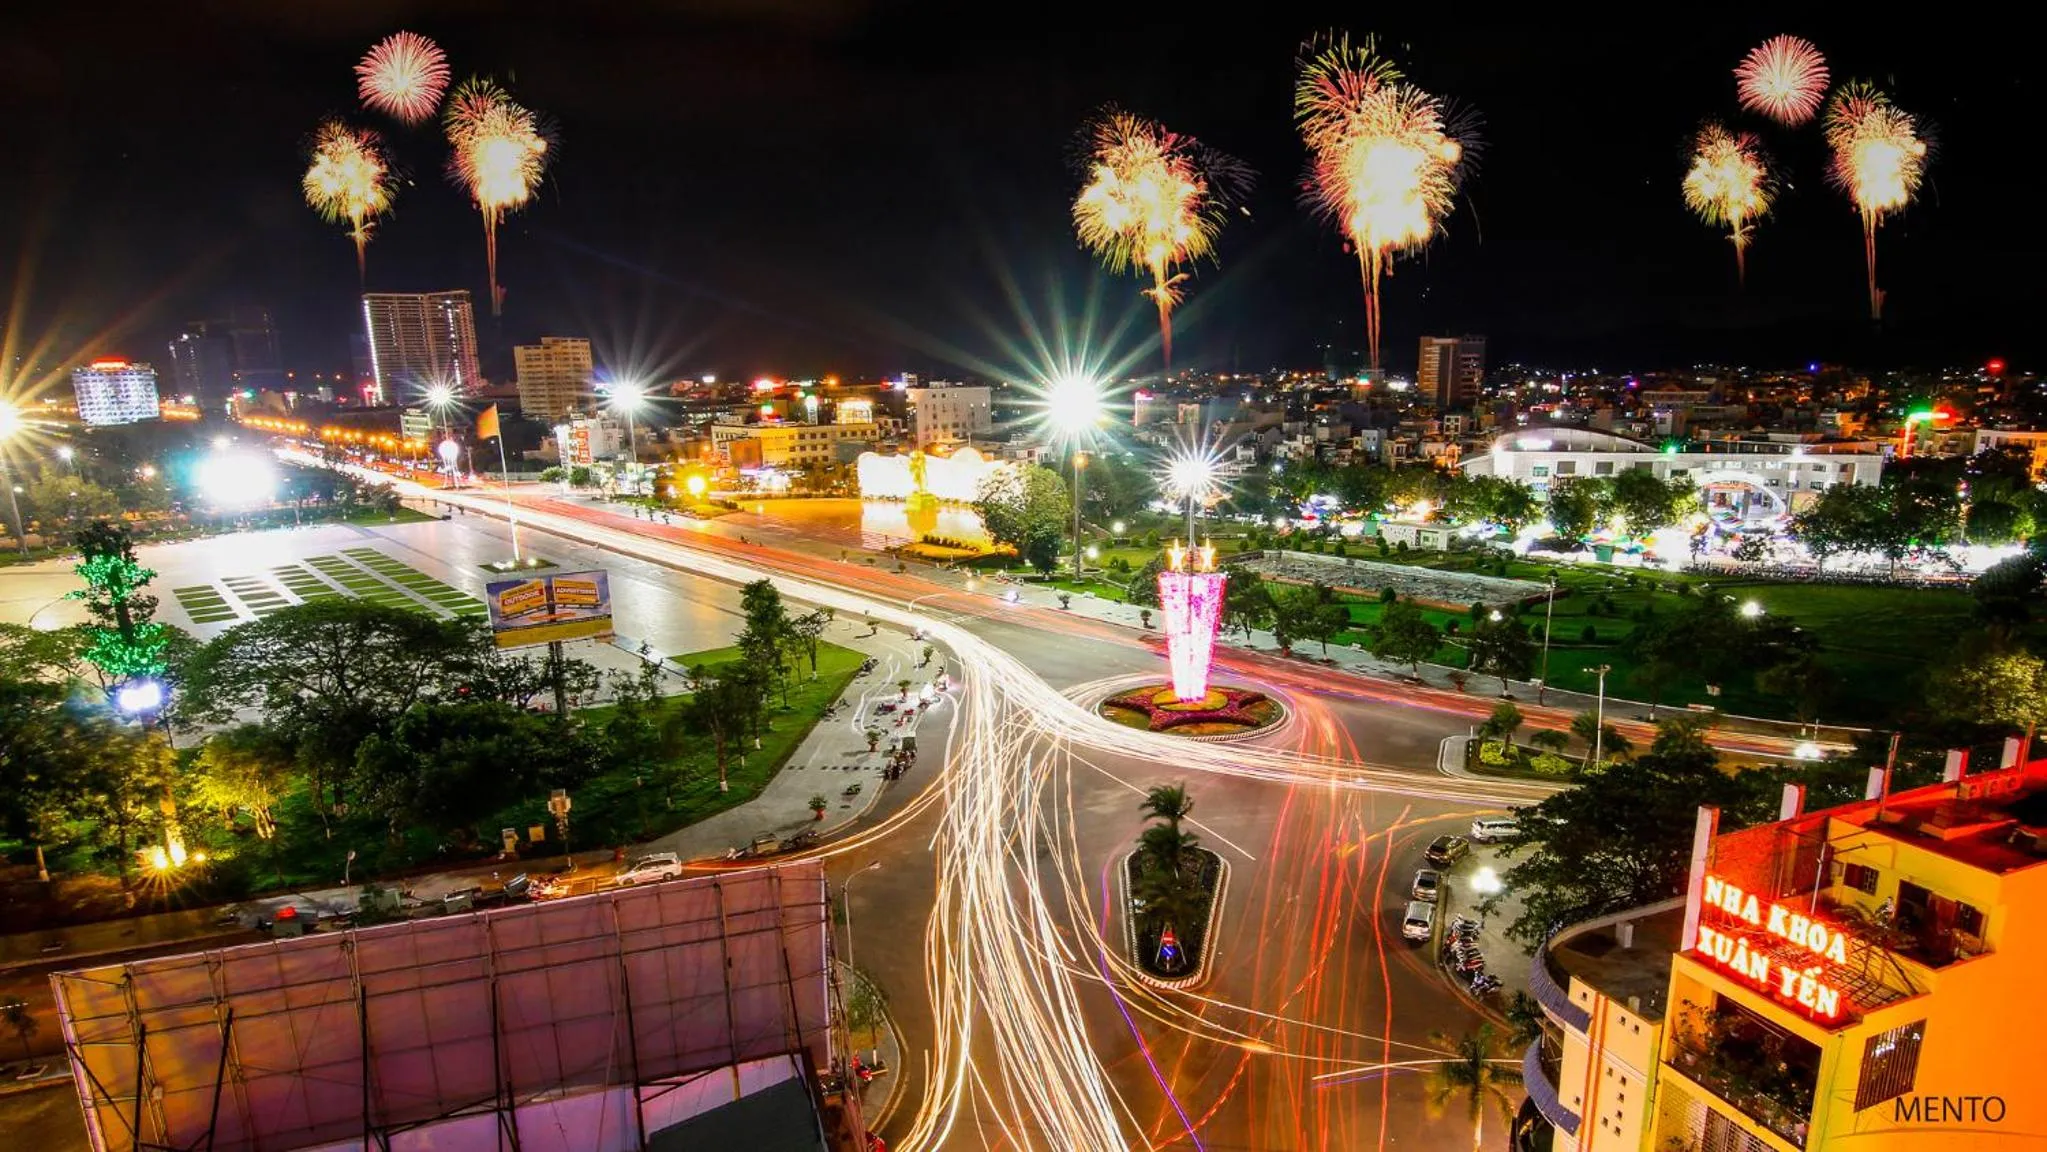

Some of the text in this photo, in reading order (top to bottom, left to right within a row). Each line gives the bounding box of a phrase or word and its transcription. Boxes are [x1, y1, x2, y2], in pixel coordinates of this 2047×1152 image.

[1704, 875, 1846, 965] NHA KHOA
[1697, 925, 1839, 1018] XUÂN YẾN
